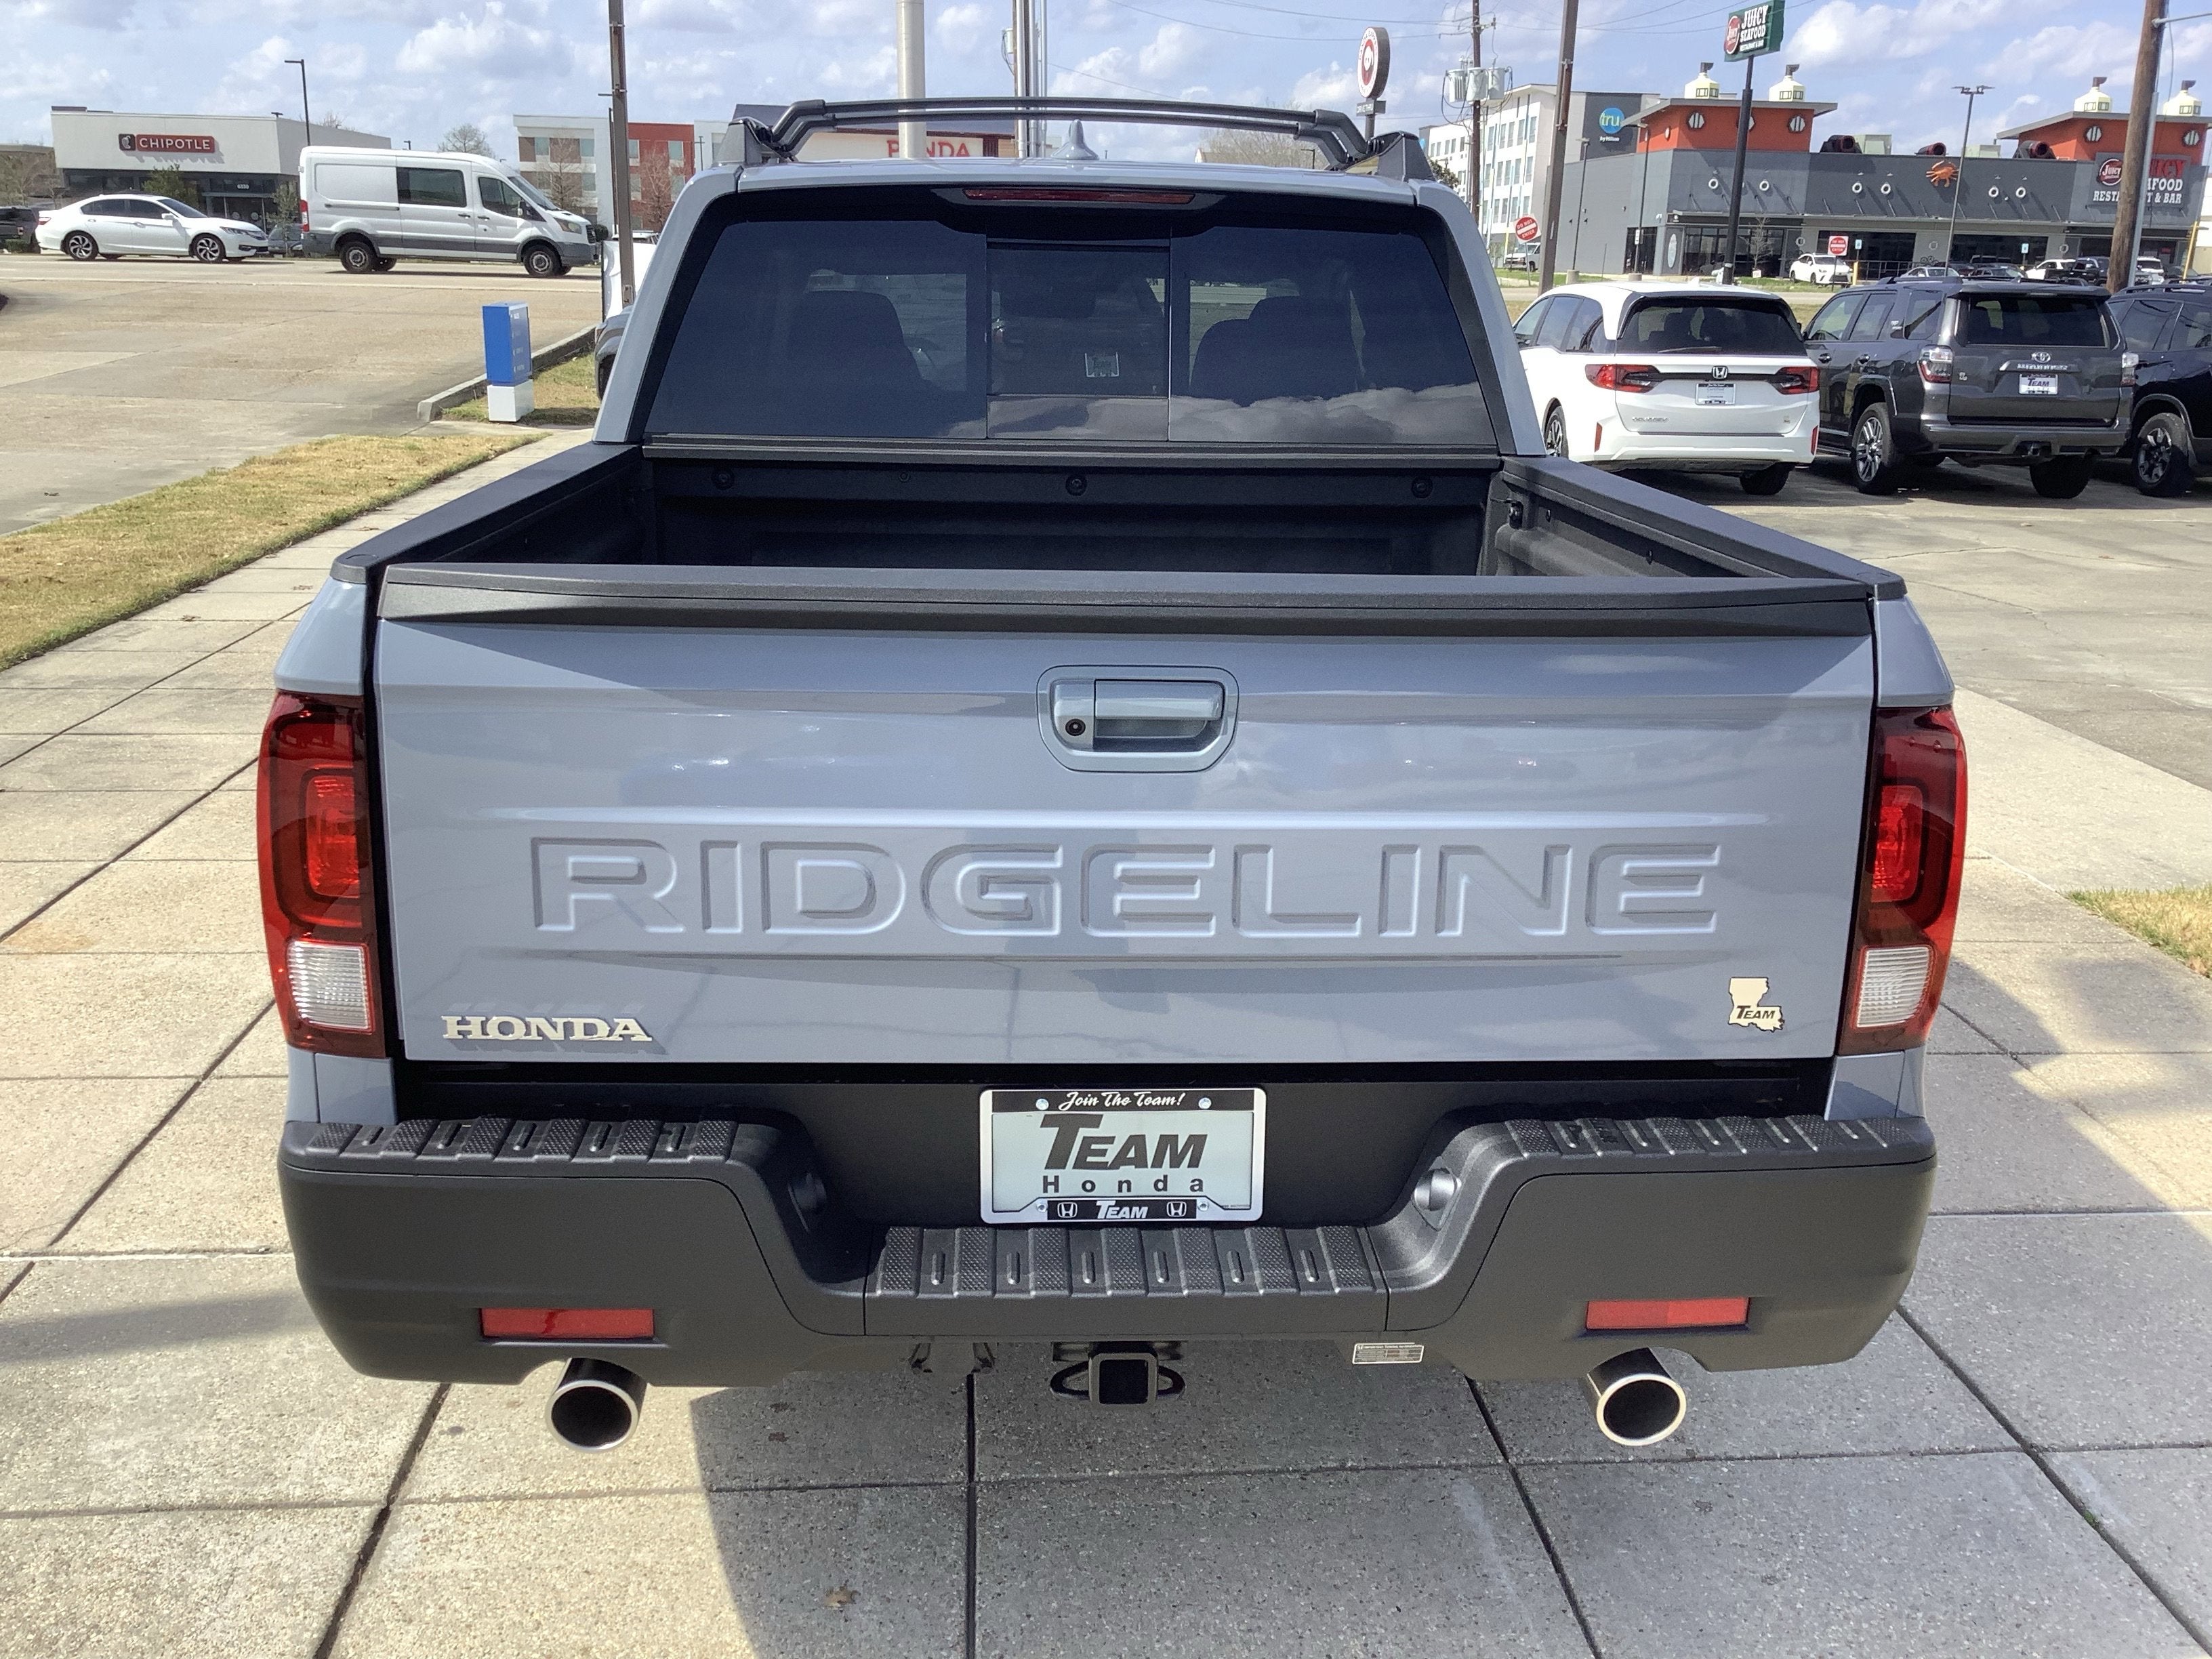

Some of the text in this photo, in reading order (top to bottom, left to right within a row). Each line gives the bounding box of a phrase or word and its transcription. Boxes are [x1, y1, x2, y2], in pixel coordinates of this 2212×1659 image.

[1741, 5, 1769, 29] JUICY
[1740, 24, 1766, 42] SEAFOOD
[1601, 112, 1620, 127] tru
[139, 138, 211, 150] CHIPOTLE
[2154, 192, 2161, 203] &
[2163, 192, 2182, 204] BAR
[1521, 229, 1535, 239] ENTER
[2028, 378, 2049, 386] TEAM
[531, 837, 1721, 935] RIDGELINE
[1736, 1006, 1776, 1019] TEAM
[441, 1016, 653, 1042] HONDA
[1058, 1091, 1186, 1111] Join The Team!
[1040, 1113, 1208, 1170] TEAM
[1042, 1174, 1204, 1193] Honda
[1096, 1200, 1149, 1219] TEAM
